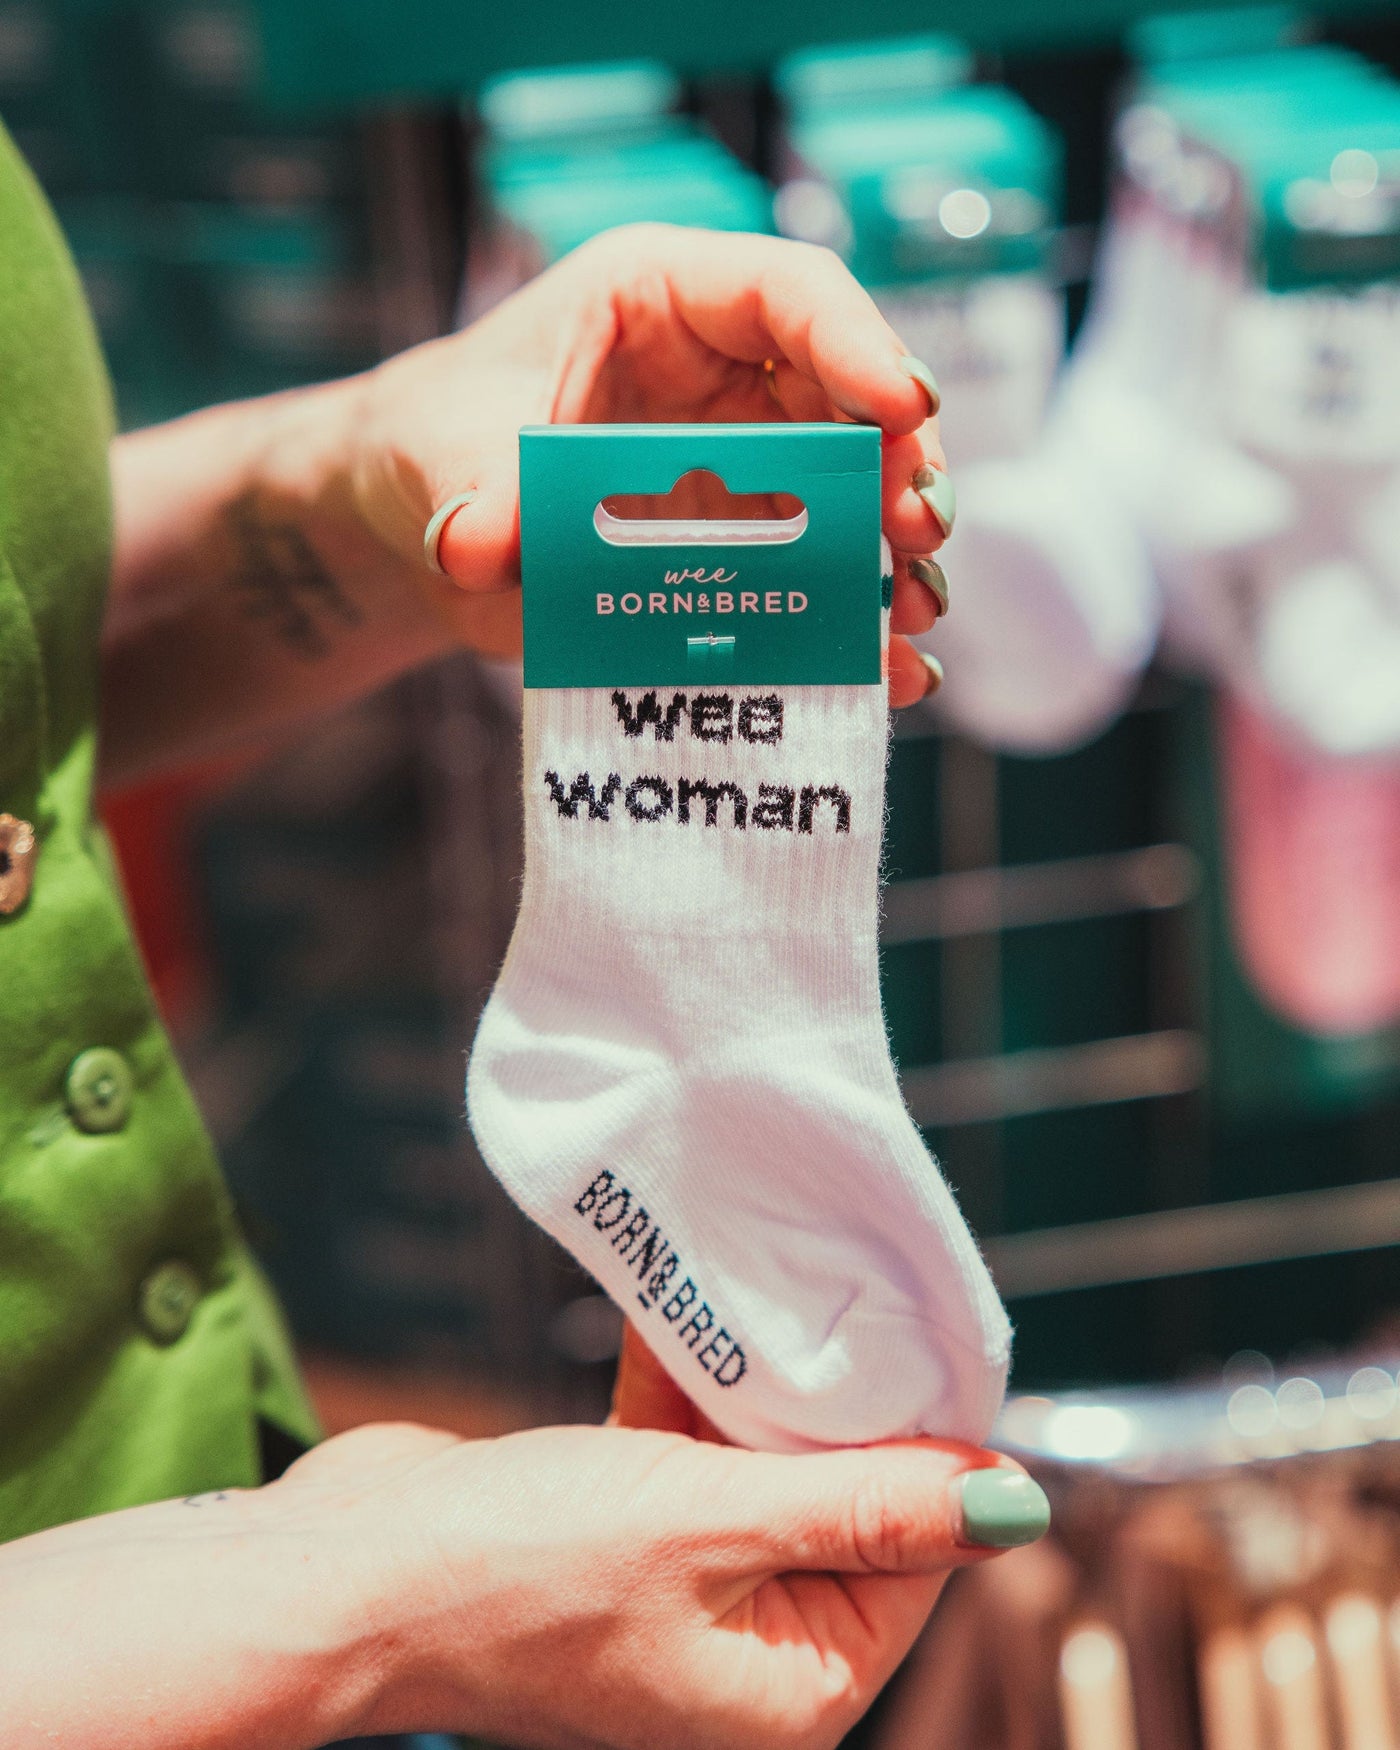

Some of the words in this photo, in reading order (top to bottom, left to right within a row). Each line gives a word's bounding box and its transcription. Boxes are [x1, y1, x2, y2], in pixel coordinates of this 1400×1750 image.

[596, 591, 809, 616] BORN&BRED
[664, 566, 738, 586] wee
[611, 688, 785, 746] wee
[543, 769, 853, 835] woman
[573, 1169, 748, 1388] BORN&BRED
